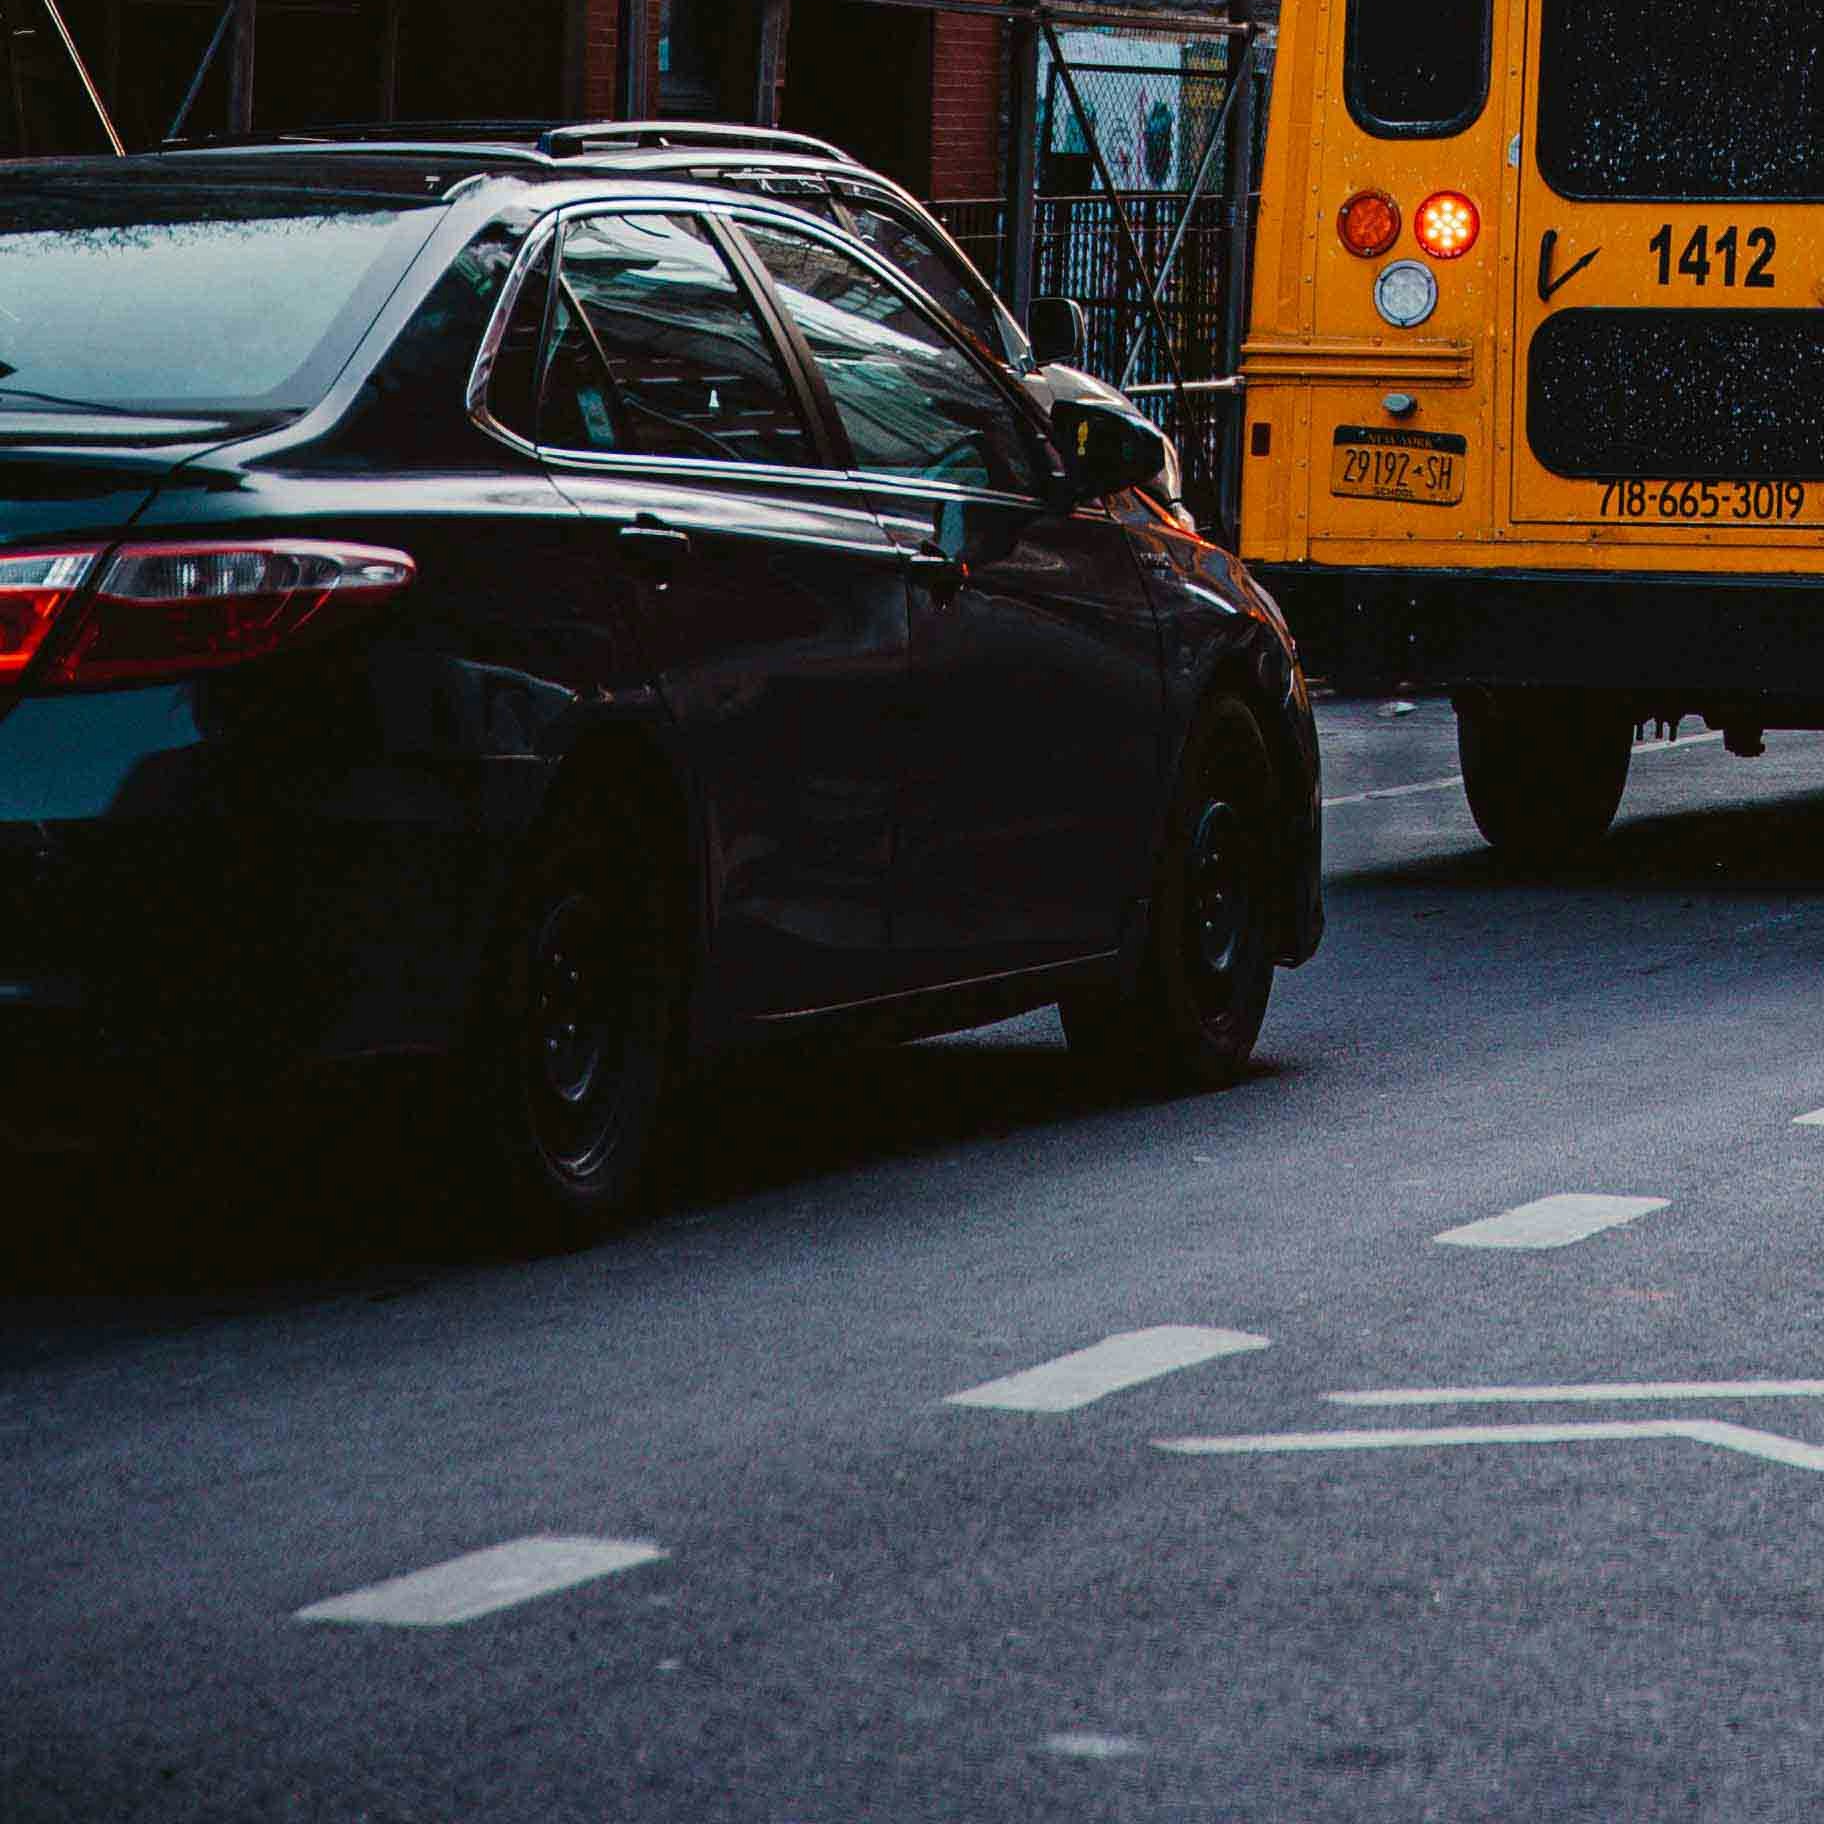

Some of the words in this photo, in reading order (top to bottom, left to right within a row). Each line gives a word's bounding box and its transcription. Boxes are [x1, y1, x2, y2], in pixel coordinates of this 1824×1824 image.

[1649, 224, 1776, 288] 1412
[1343, 448, 1410, 487] 29192
[1425, 455, 1453, 490] SH
[1598, 479, 1806, 520] 718-665-3019
